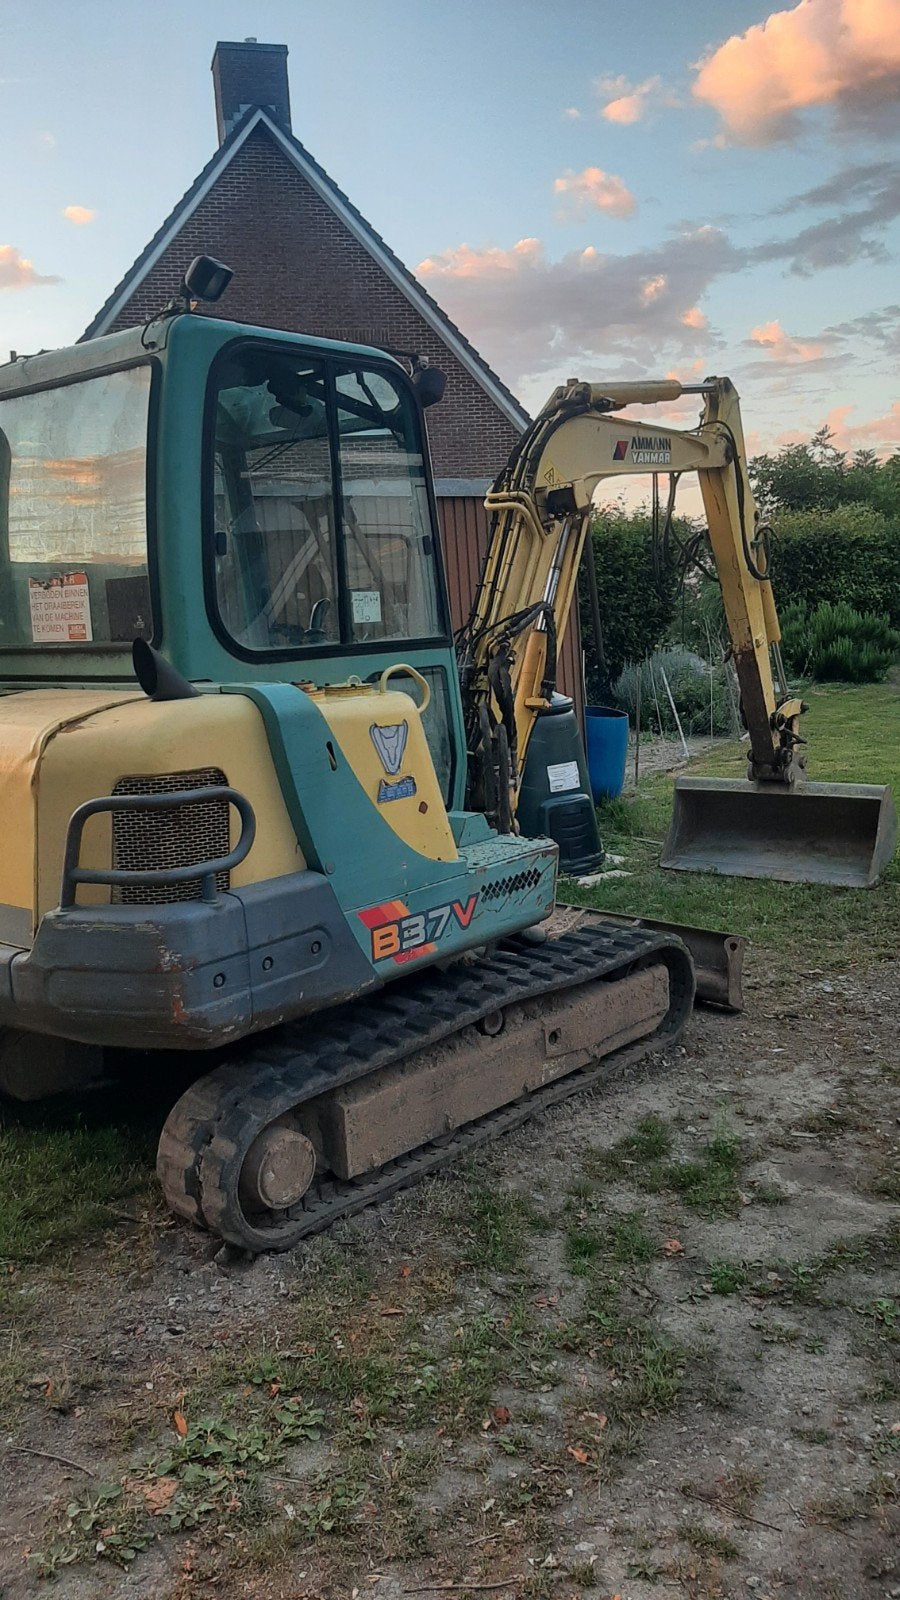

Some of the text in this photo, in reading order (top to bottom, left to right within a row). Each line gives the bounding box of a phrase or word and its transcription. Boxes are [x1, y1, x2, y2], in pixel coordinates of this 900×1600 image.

[631, 437, 671, 450] AMMANN
[631, 451, 671, 464] YANMAR
[31, 588, 88, 599] VERBODEN BINNEN
[32, 602, 43, 611] HET
[33, 611, 84, 622] VAN DE MACHINE
[33, 624, 41, 633] TE
[42, 623, 65, 633] KOMEN
[371, 892, 480, 964] B37V
